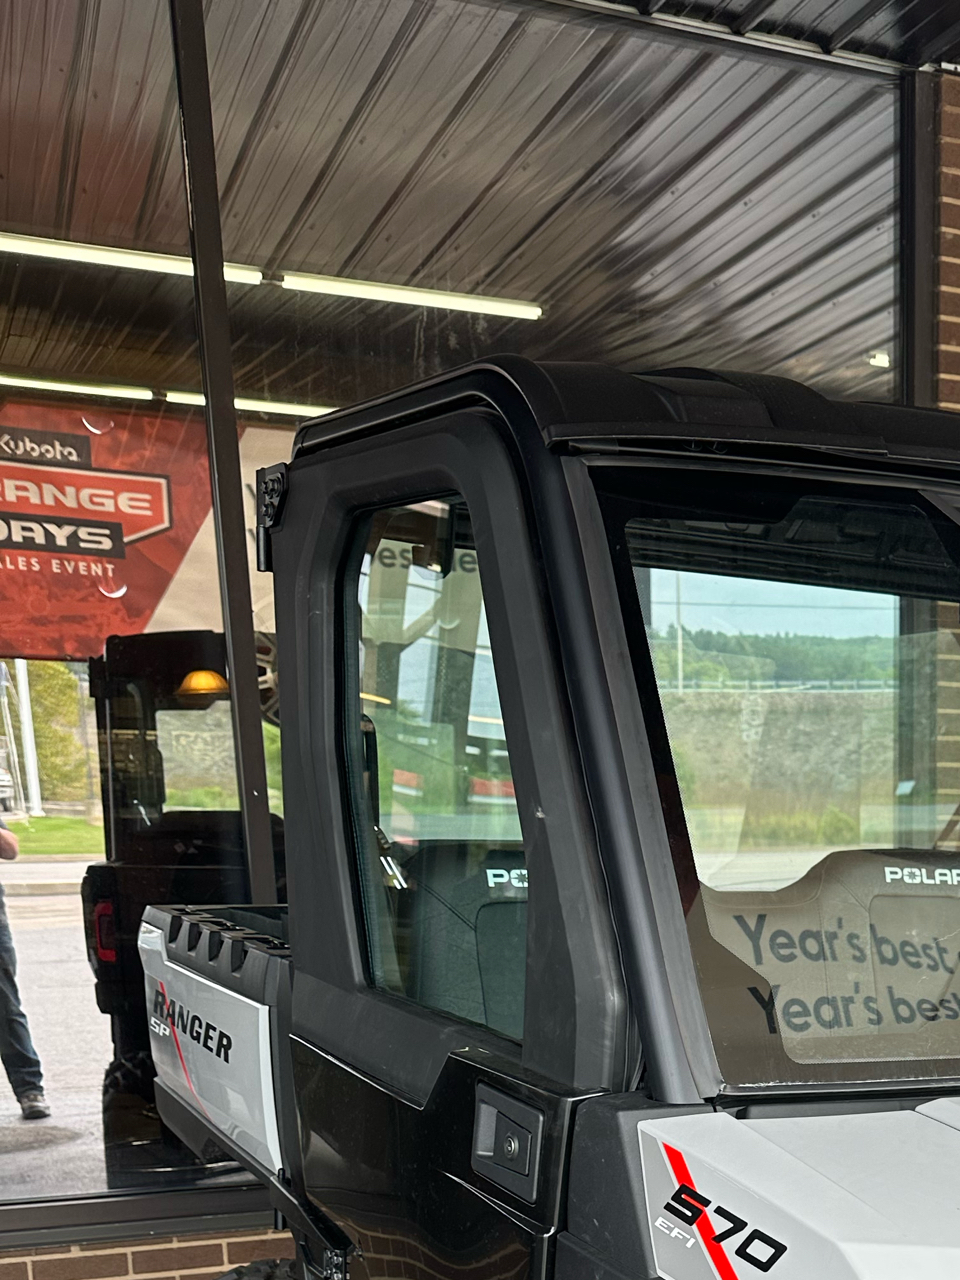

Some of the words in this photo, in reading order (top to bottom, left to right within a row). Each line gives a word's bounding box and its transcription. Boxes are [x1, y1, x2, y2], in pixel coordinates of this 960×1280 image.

[0, 478, 153, 516] ANGE
[0, 554, 41, 572] LES
[51, 559, 115, 577] EVENT
[733, 912, 867, 967] Year's
[868, 922, 955, 975] best
[150, 1015, 171, 1037] SP
[153, 988, 233, 1065] RANGER
[747, 981, 884, 1035] Year's
[654, 1215, 696, 1249] EFI
[662, 1182, 788, 1273] 570
